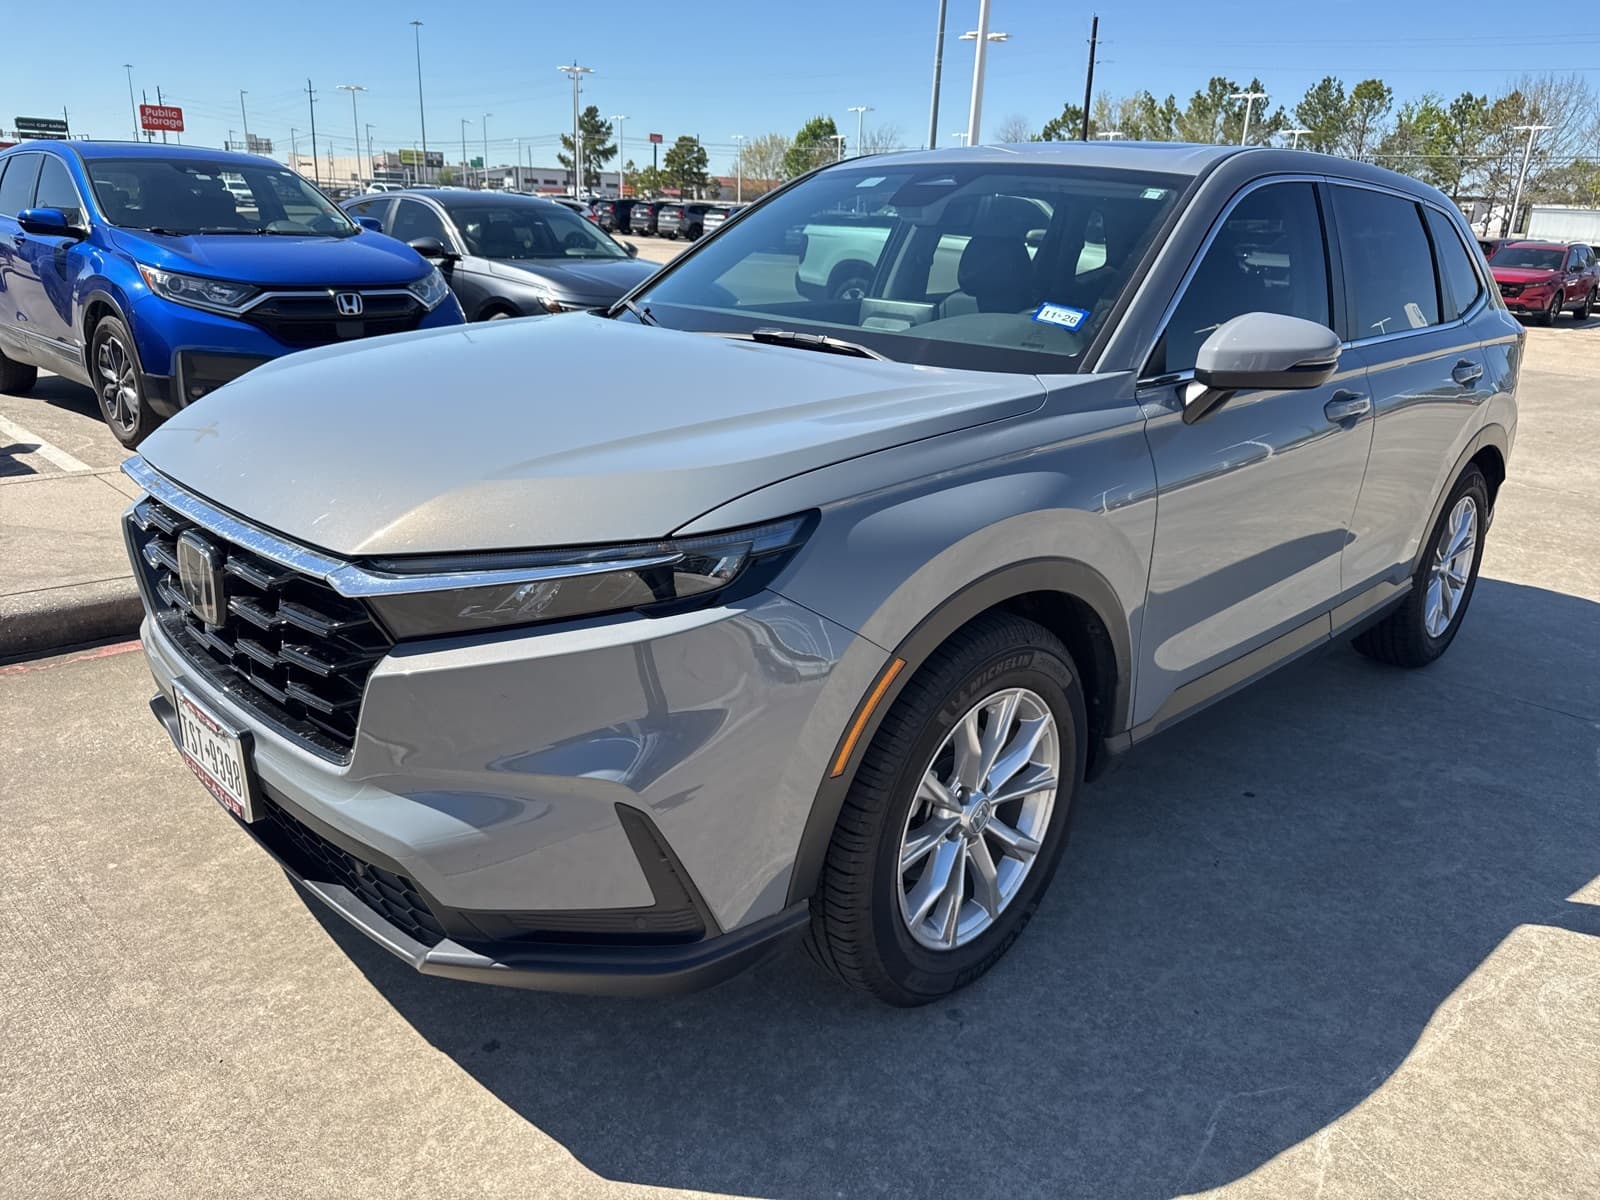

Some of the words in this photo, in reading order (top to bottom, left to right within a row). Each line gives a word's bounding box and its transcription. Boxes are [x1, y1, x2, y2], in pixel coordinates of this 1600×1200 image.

[144, 107, 178, 119] Public
[142, 116, 183, 129] Storage
[970, 655, 1032, 693] MICHELIN
